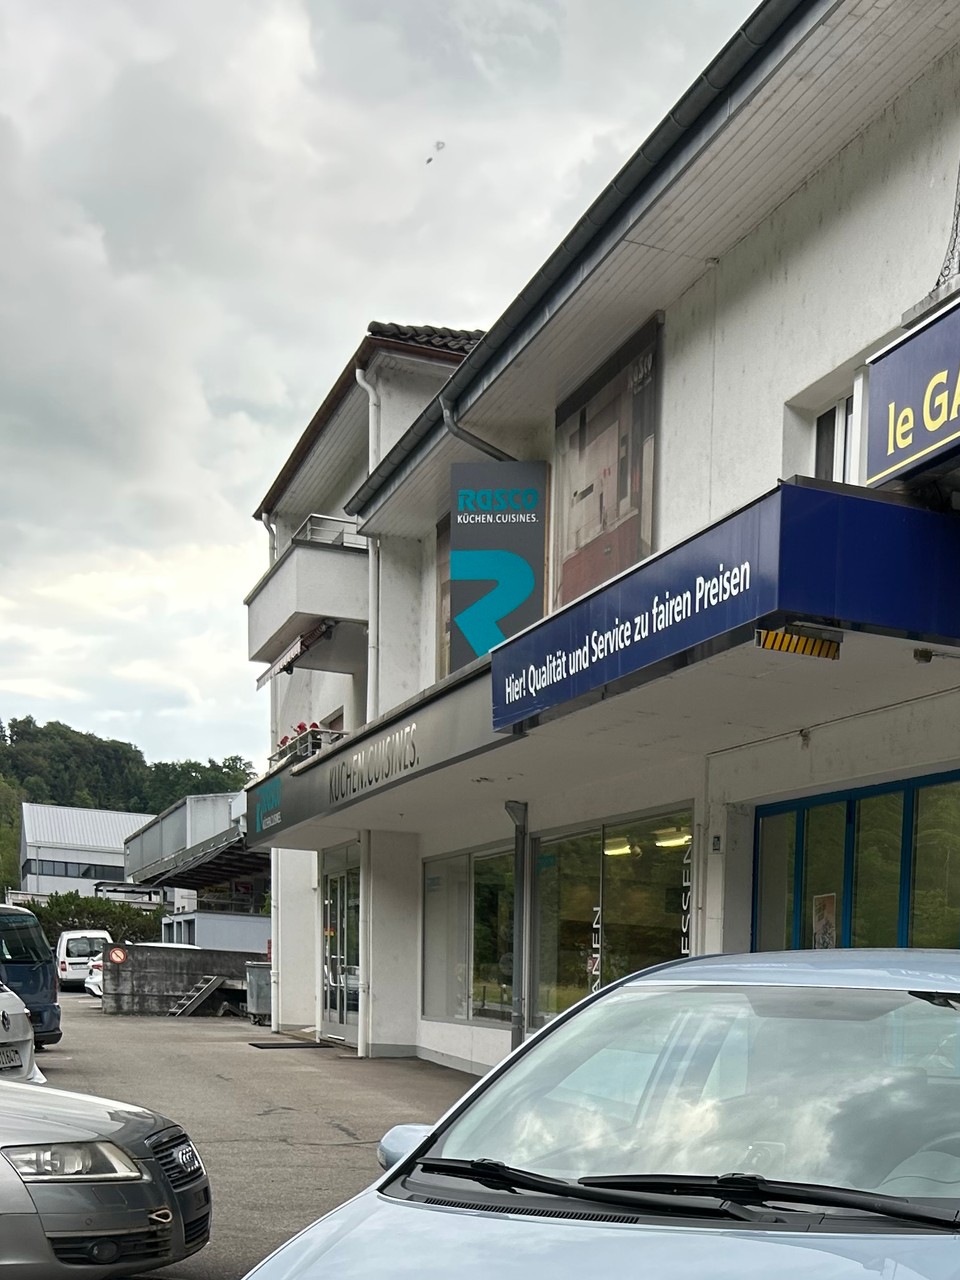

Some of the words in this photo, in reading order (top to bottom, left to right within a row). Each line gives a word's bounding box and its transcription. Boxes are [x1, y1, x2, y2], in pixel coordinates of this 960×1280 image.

[886, 401, 914, 456] le
[457, 513, 539, 524] KÜCHEN.CUISINES.
[505, 669, 526, 705] Hier!
[528, 650, 567, 697] Qualität
[569, 636, 590, 676] und
[591, 618, 631, 662] Service
[634, 611, 649, 642] zu
[652, 591, 691, 633] fairen
[695, 561, 750, 613] Preisen
